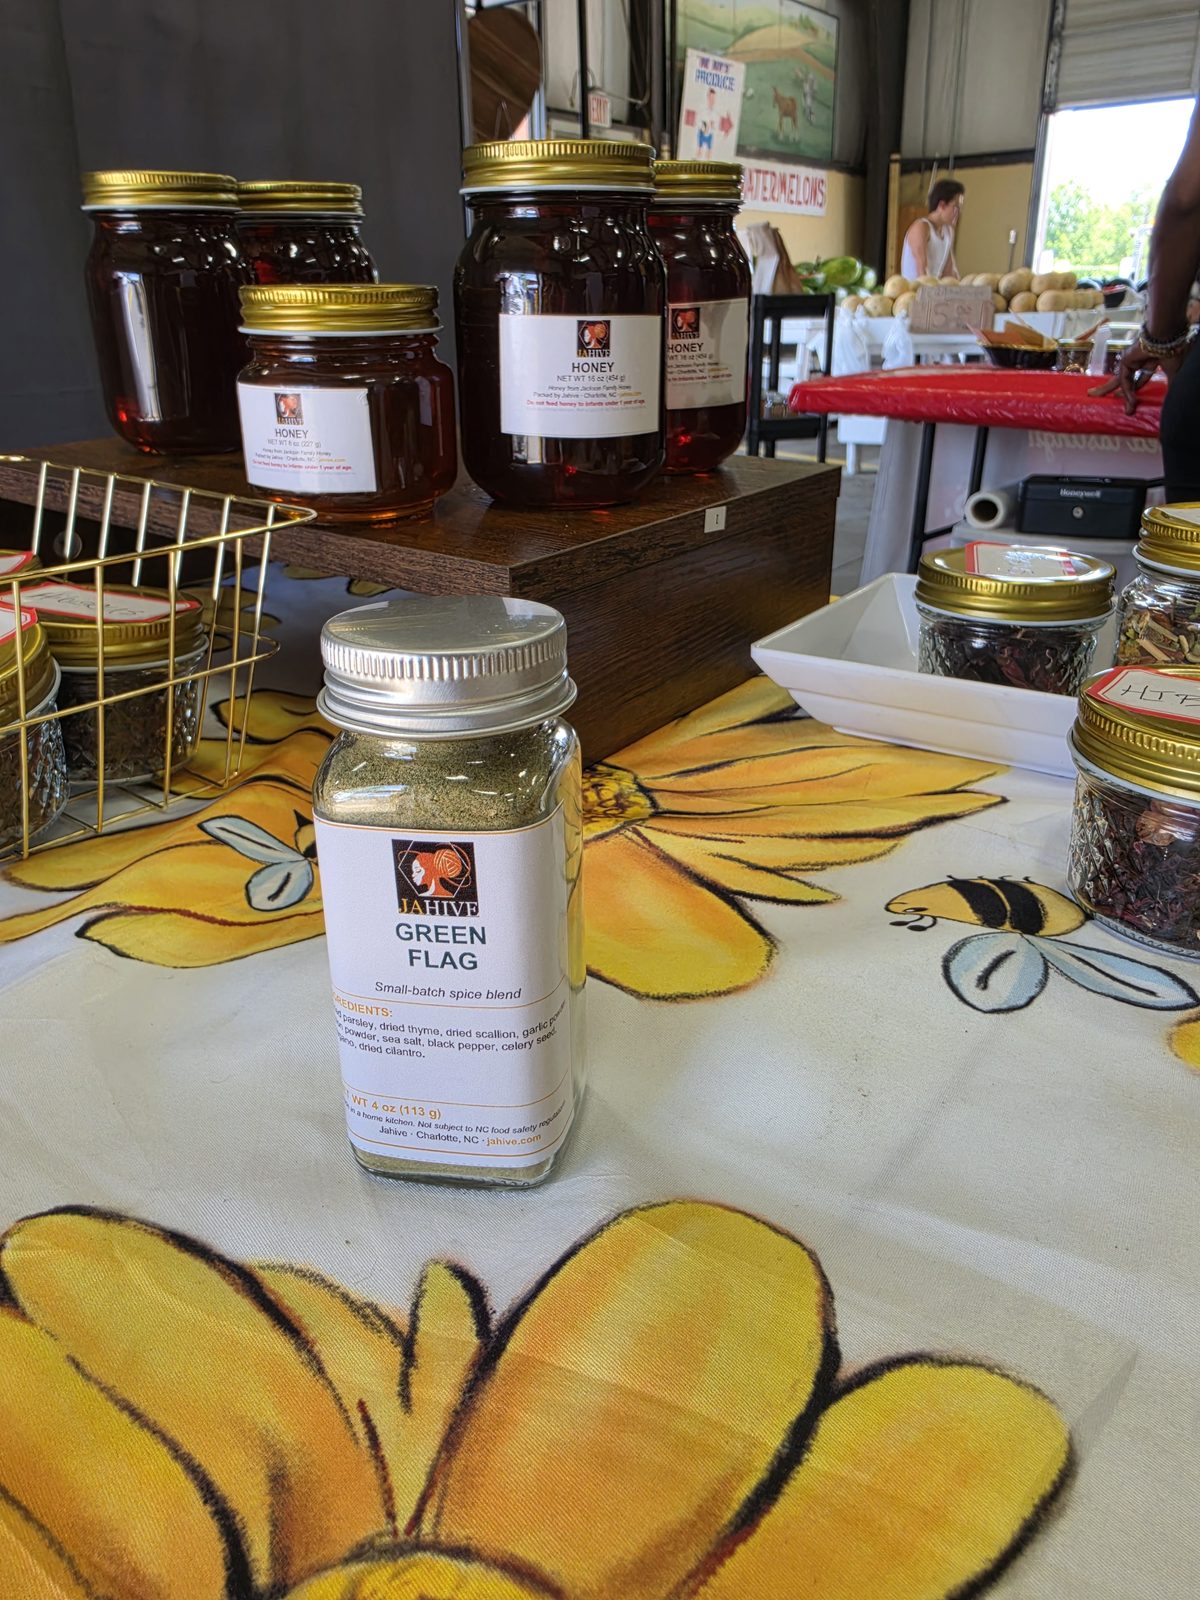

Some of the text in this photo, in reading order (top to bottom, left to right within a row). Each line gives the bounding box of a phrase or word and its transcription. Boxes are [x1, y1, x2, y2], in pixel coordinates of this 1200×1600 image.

[743, 168, 825, 208] ATERMELONS
[572, 362, 615, 373] HONEY
[275, 428, 309, 439] HONEY
[397, 898, 479, 917] JAHIVE
[395, 922, 487, 945] GREEN
[408, 949, 479, 970] FLAG
[375, 981, 522, 1001] Small-batch spice blend
[342, 1014, 377, 1031] parsley,
[379, 1022, 405, 1033] dried
[408, 1025, 443, 1037] thyme,
[446, 1028, 472, 1038] dried
[475, 1029, 519, 1040] scallion,
[522, 1021, 548, 1039] garlic
[344, 1026, 380, 1043] powder,
[382, 1035, 401, 1044] sea
[403, 1037, 425, 1047] salt,
[427, 1038, 455, 1049] black
[458, 1042, 499, 1052] pepper,
[501, 1039, 534, 1051] celery
[358, 1042, 383, 1054] dried
[385, 1046, 426, 1058] cilantro.
[351, 1094, 368, 1107] WT
[371, 1100, 379, 1110] 4
[381, 1104, 396, 1113] oz
[399, 1104, 425, 1117] (113
[428, 1108, 441, 1120] g)
[362, 1110, 383, 1122] home
[417, 1120, 432, 1129] Not
[434, 1122, 463, 1133] subject
[465, 1124, 473, 1133] to
[475, 1124, 489, 1134] NC
[491, 1126, 511, 1134] food
[512, 1123, 538, 1135] safety
[379, 1125, 542, 1147] Jahive Charlotte, NC jahive.com
